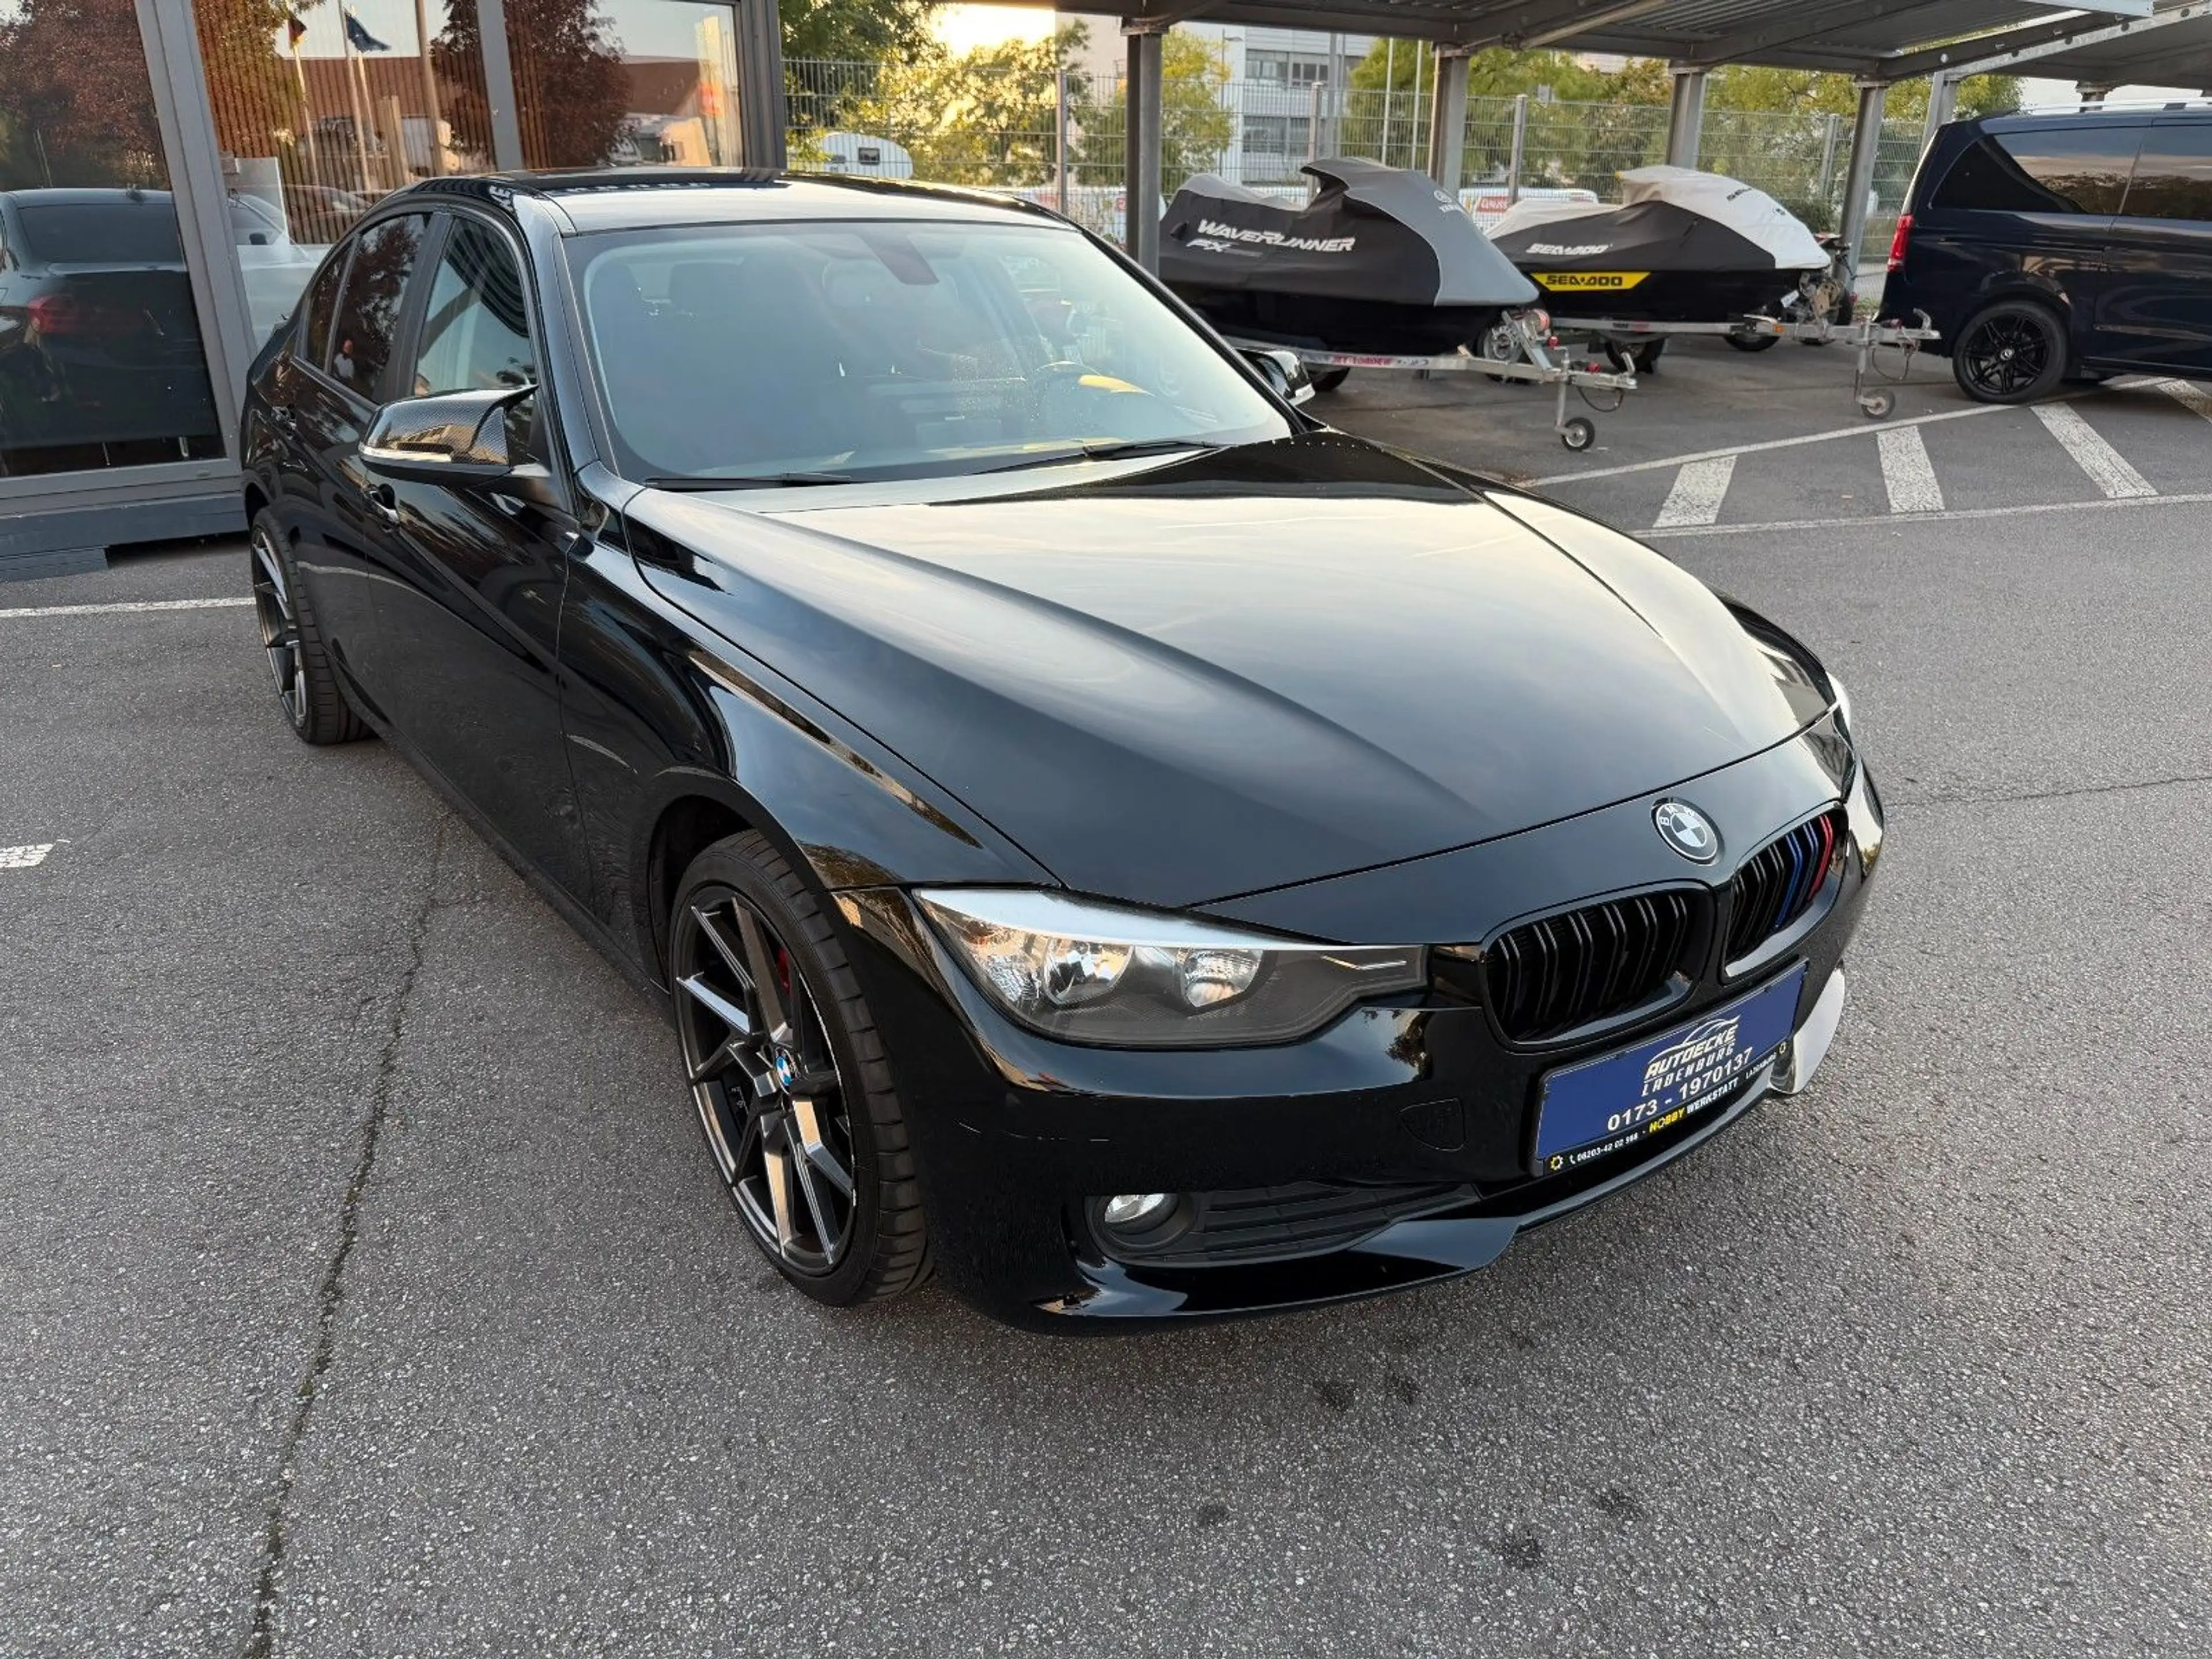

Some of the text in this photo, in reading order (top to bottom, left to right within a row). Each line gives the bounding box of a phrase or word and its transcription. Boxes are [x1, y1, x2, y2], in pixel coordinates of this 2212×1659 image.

[1198, 219, 1355, 252] WAVERUNNER
[1641, 1042, 1736, 1096] LADENBURG
[1645, 1024, 1739, 1080] AUTOECKE
[1607, 1099, 1657, 1131] 0173
[1679, 1046, 1753, 1100] 1970137
[1649, 1107, 1685, 1133] HOBBY
[1687, 1077, 1739, 1113] WERKSTATT
